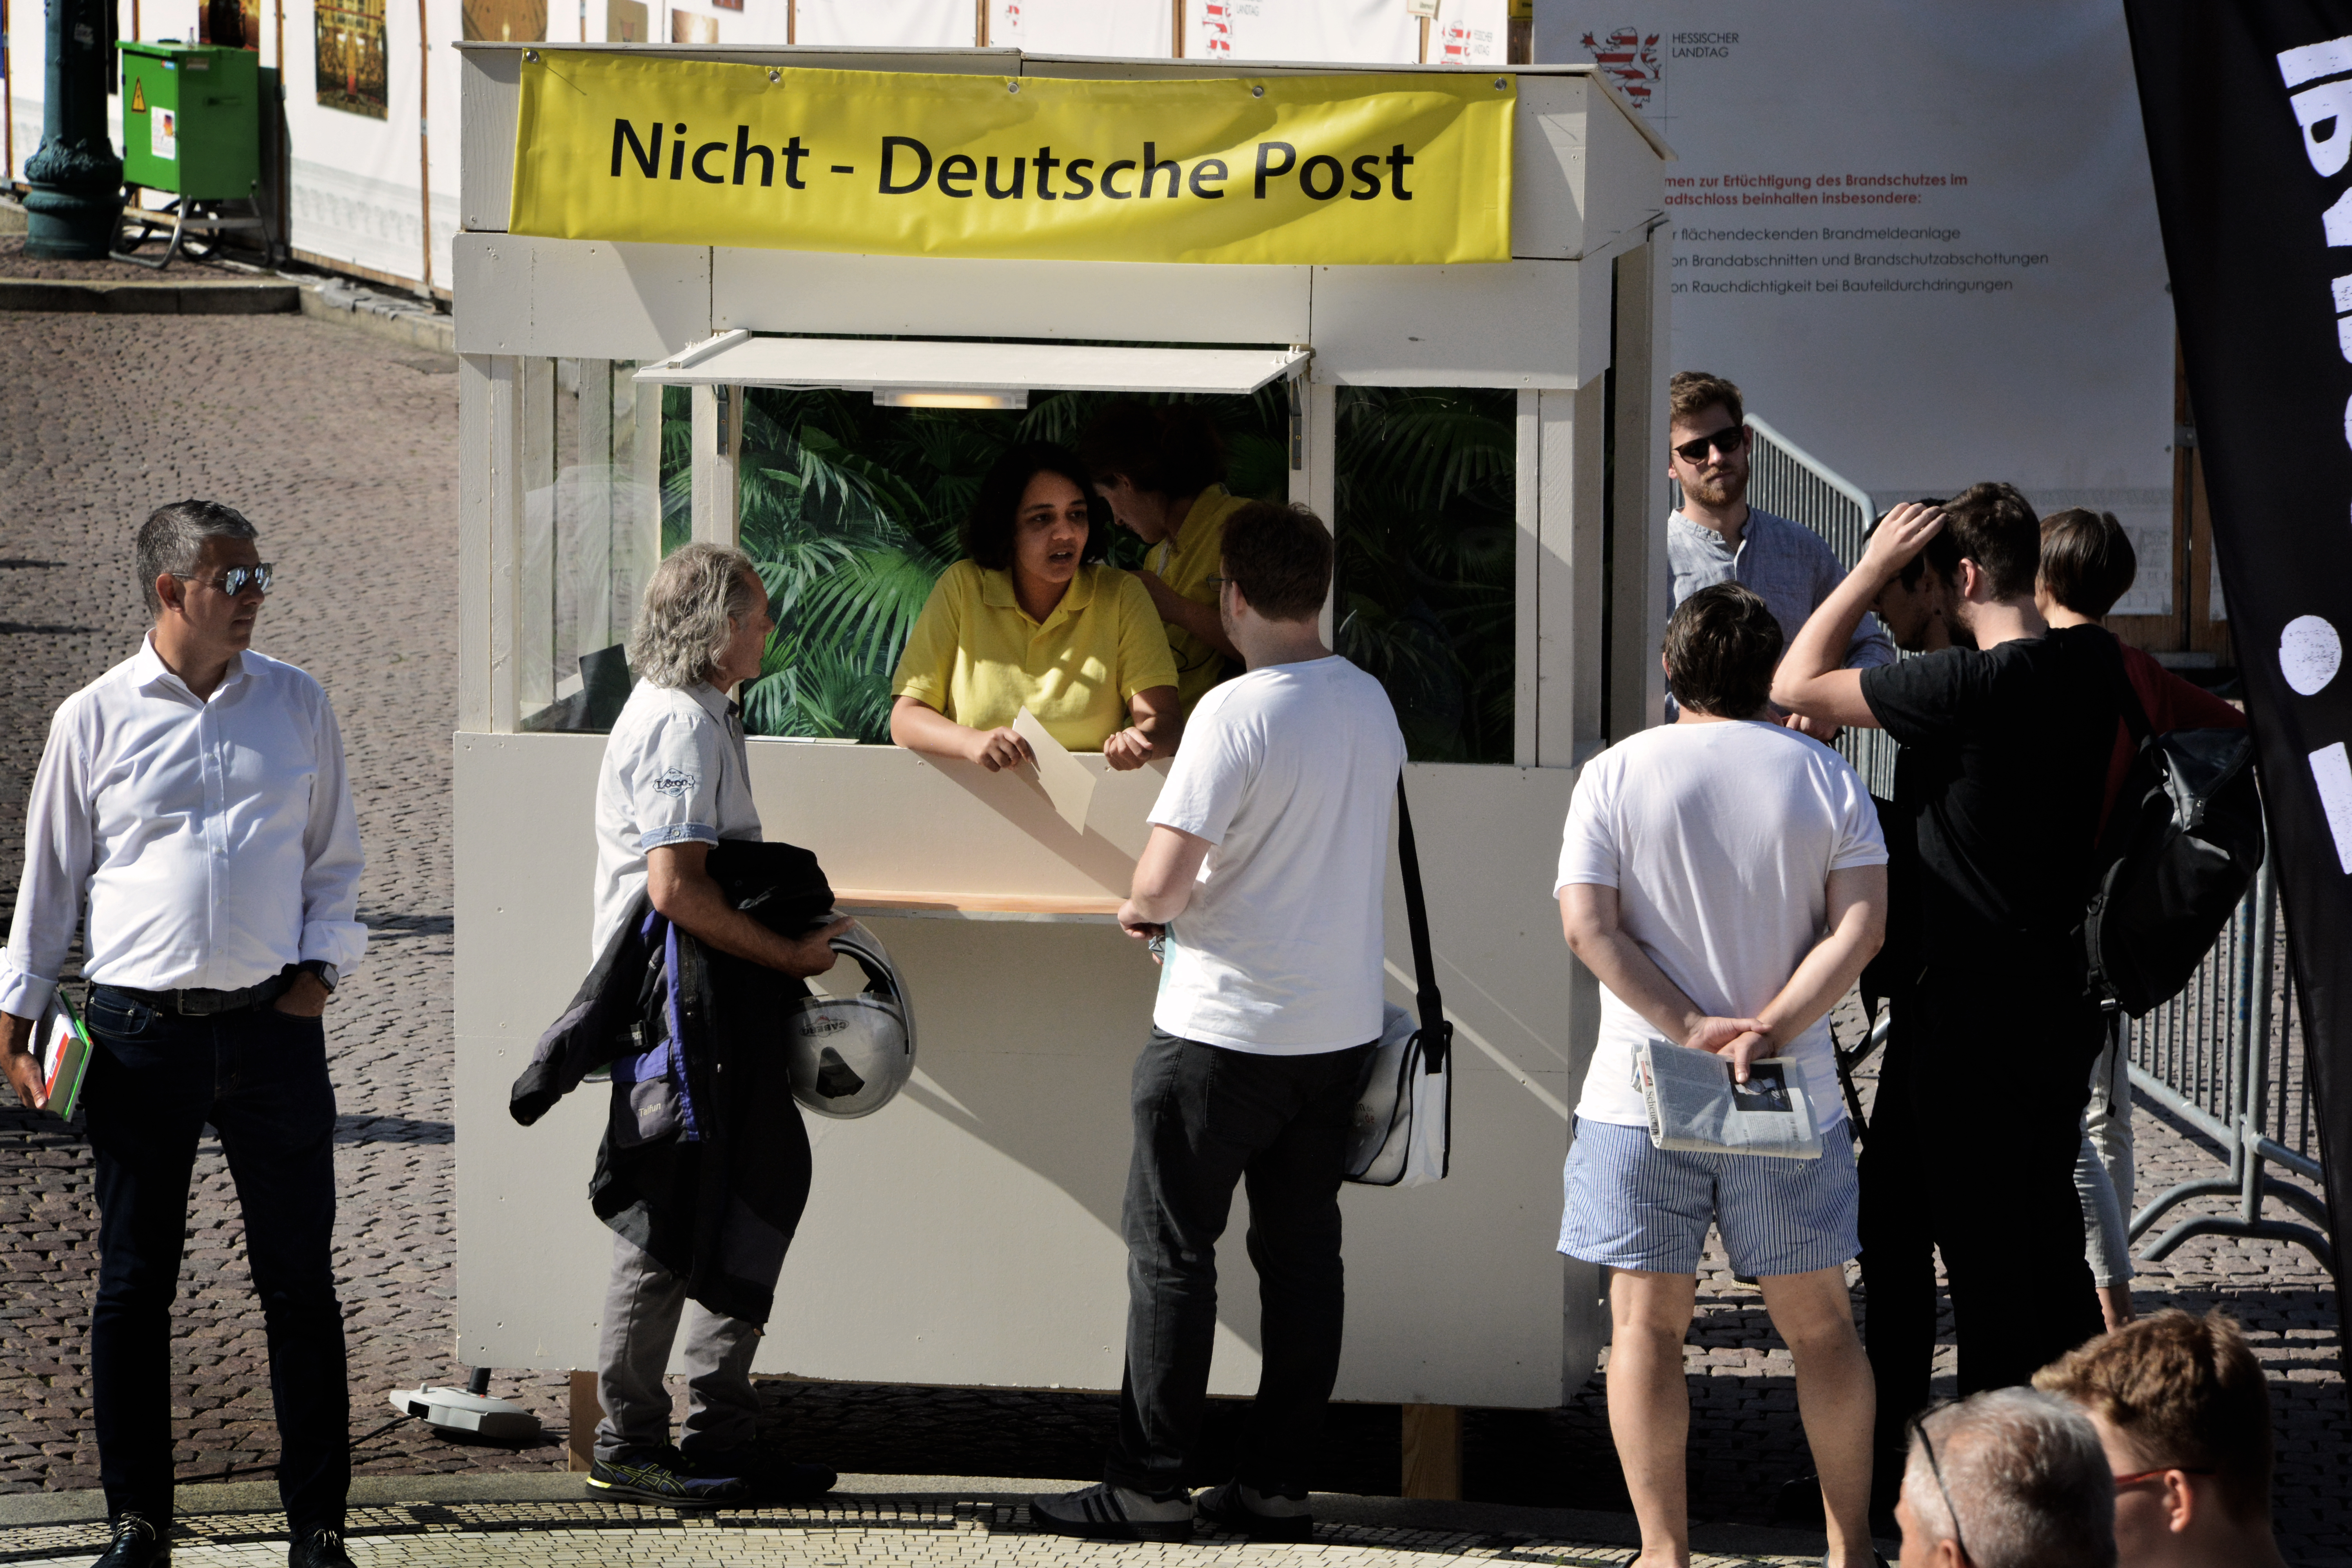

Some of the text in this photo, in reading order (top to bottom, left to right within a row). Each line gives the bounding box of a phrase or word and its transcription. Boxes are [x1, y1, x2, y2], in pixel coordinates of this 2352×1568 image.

[1672, 33, 1739, 44] HESSISCHER
[1672, 47, 1729, 58] LANDTAG
[610, 118, 1414, 201] Nicht - Deutsche Post
[1700, 178, 1719, 187] zur
[1723, 174, 1811, 189] Ertüchtigung
[1816, 174, 1840, 186] des
[1846, 174, 1946, 186] Brandschutzes
[1951, 174, 1968, 185] im
[1742, 193, 1818, 205] beinhalten
[1822, 192, 1922, 205] insbesondere:
[1682, 228, 1818, 241] flächendeckenden
[1823, 227, 1961, 242] Brandmeldeanlage
[1692, 254, 1818, 267] Brandabschnitten
[1822, 254, 1849, 266] und
[1854, 253, 2048, 267] Brandschutzabschottungen
[1692, 280, 1812, 295] Rauchdichtigkeit
[1816, 280, 1838, 292] bei
[1842, 278, 2013, 294] Bauteildurchdringungen
[638, 1103, 661, 1117] Taifun
[1646, 1091, 1658, 1126] Scheuer
